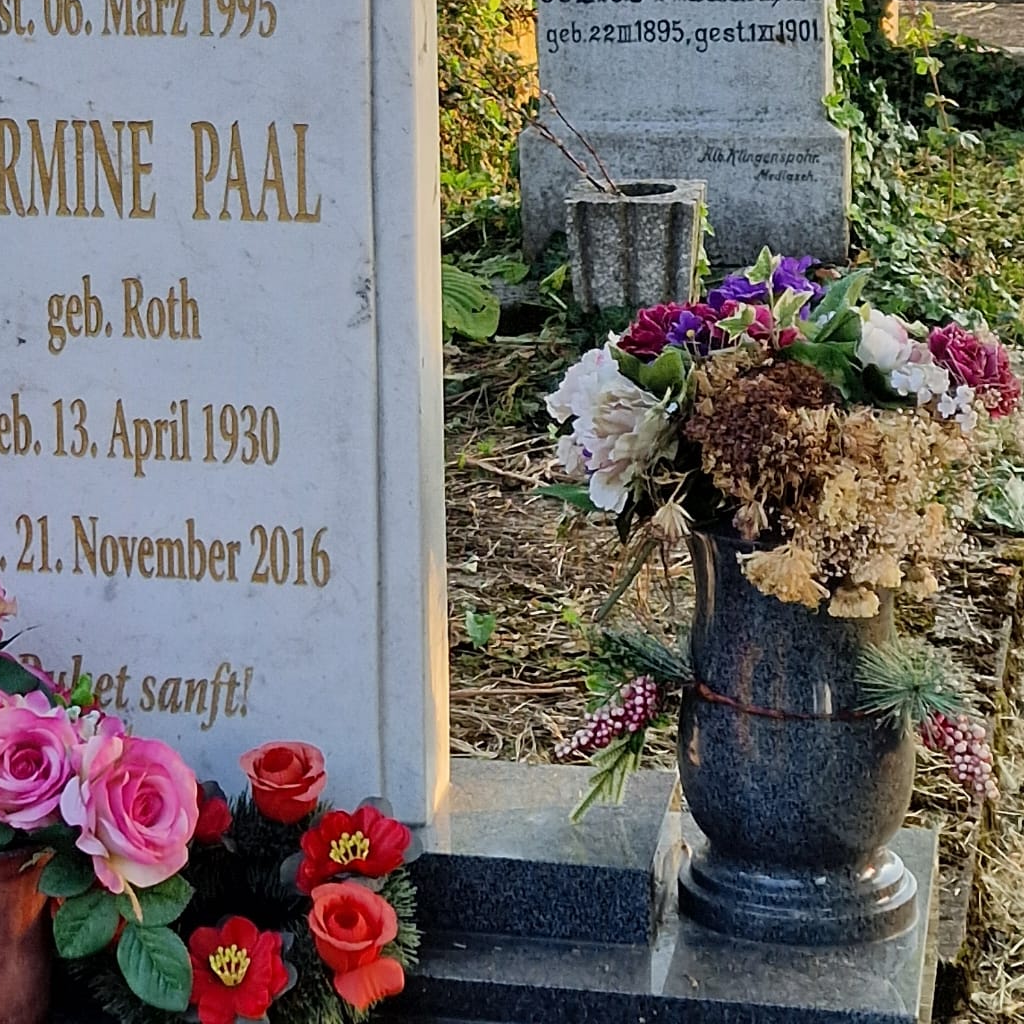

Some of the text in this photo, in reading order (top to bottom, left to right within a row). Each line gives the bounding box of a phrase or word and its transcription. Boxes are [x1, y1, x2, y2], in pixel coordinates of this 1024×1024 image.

[190, 120, 322, 224] PAAL
[46, 275, 202, 356] geb. Roth
[51, 398, 98, 459] 13.
[107, 398, 191, 479] April
[202, 403, 280, 465] 1930
[15, 513, 63, 574] 21.
[70, 515, 241, 583] November
[249, 524, 332, 588] 2016
[139, 661, 254, 732] sanft!
